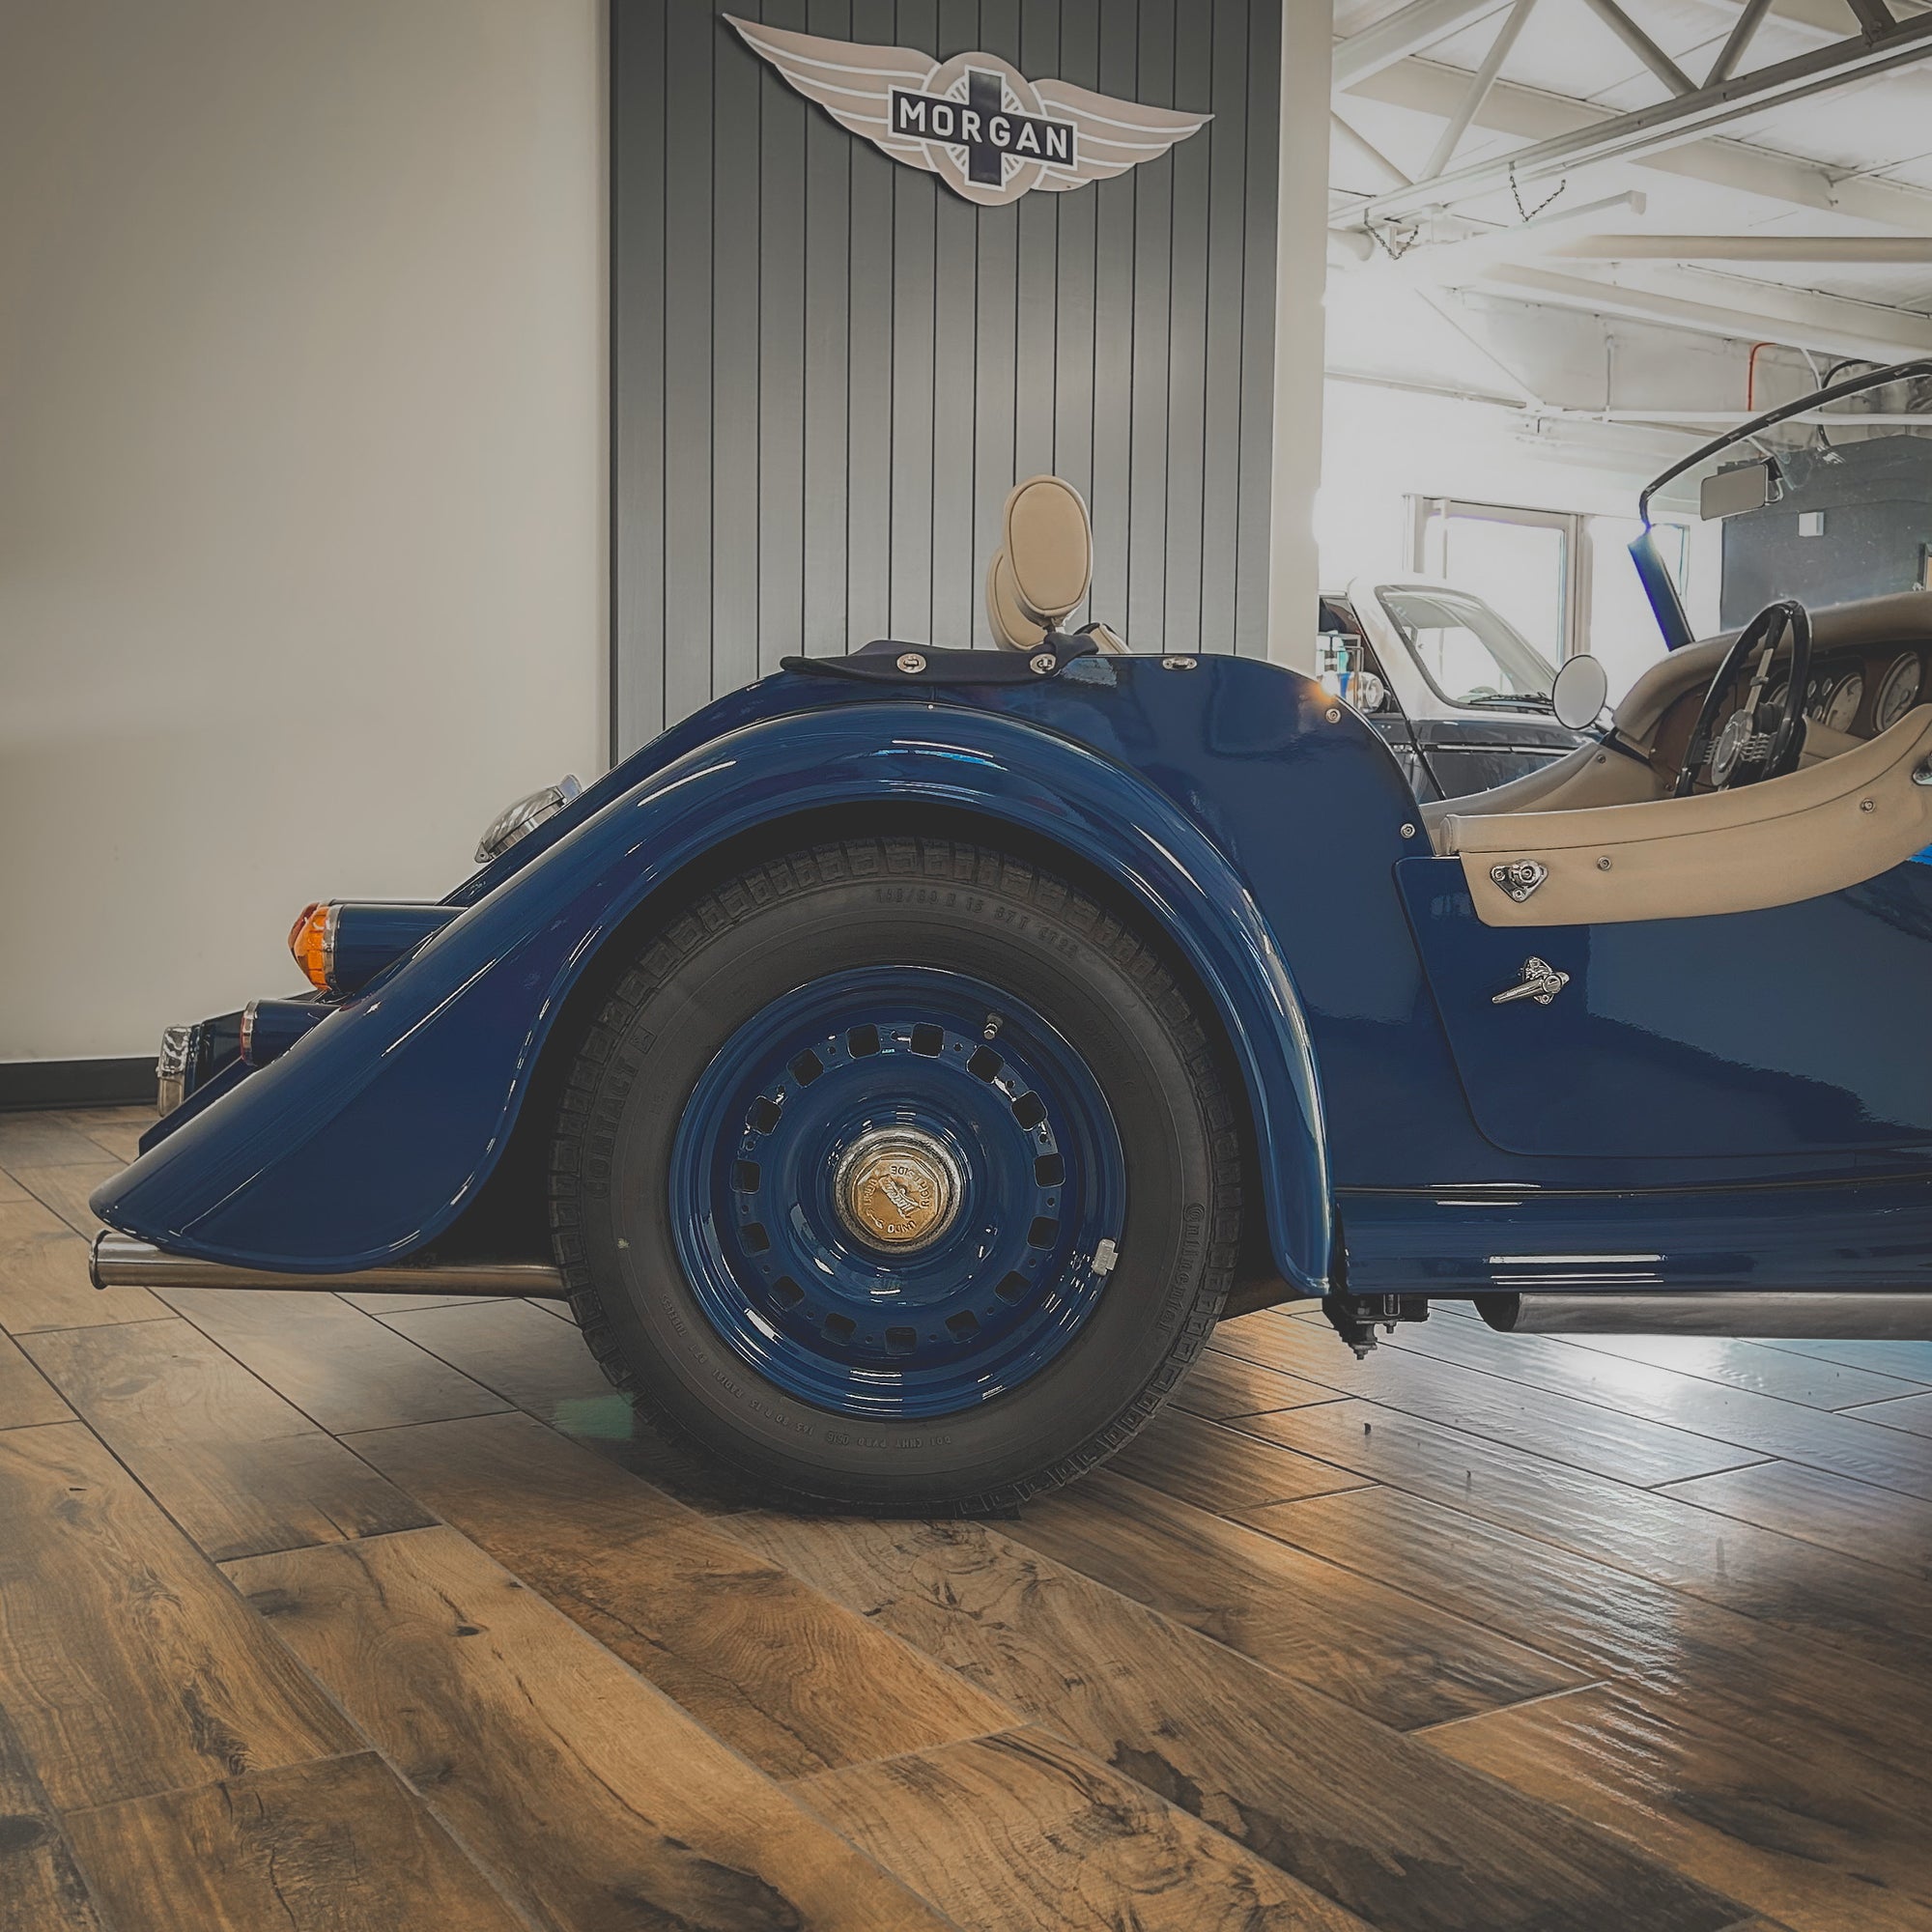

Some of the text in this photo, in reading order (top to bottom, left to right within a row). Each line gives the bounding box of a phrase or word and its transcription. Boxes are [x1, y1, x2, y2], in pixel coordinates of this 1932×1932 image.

[899, 97, 1067, 158] MORGAN
[585, 1055, 639, 1199] CONTACT
[1156, 1202, 1206, 1336] Continental
[656, 1291, 689, 1338] TUBELESS
[709, 1367, 744, 1399] RADIAL
